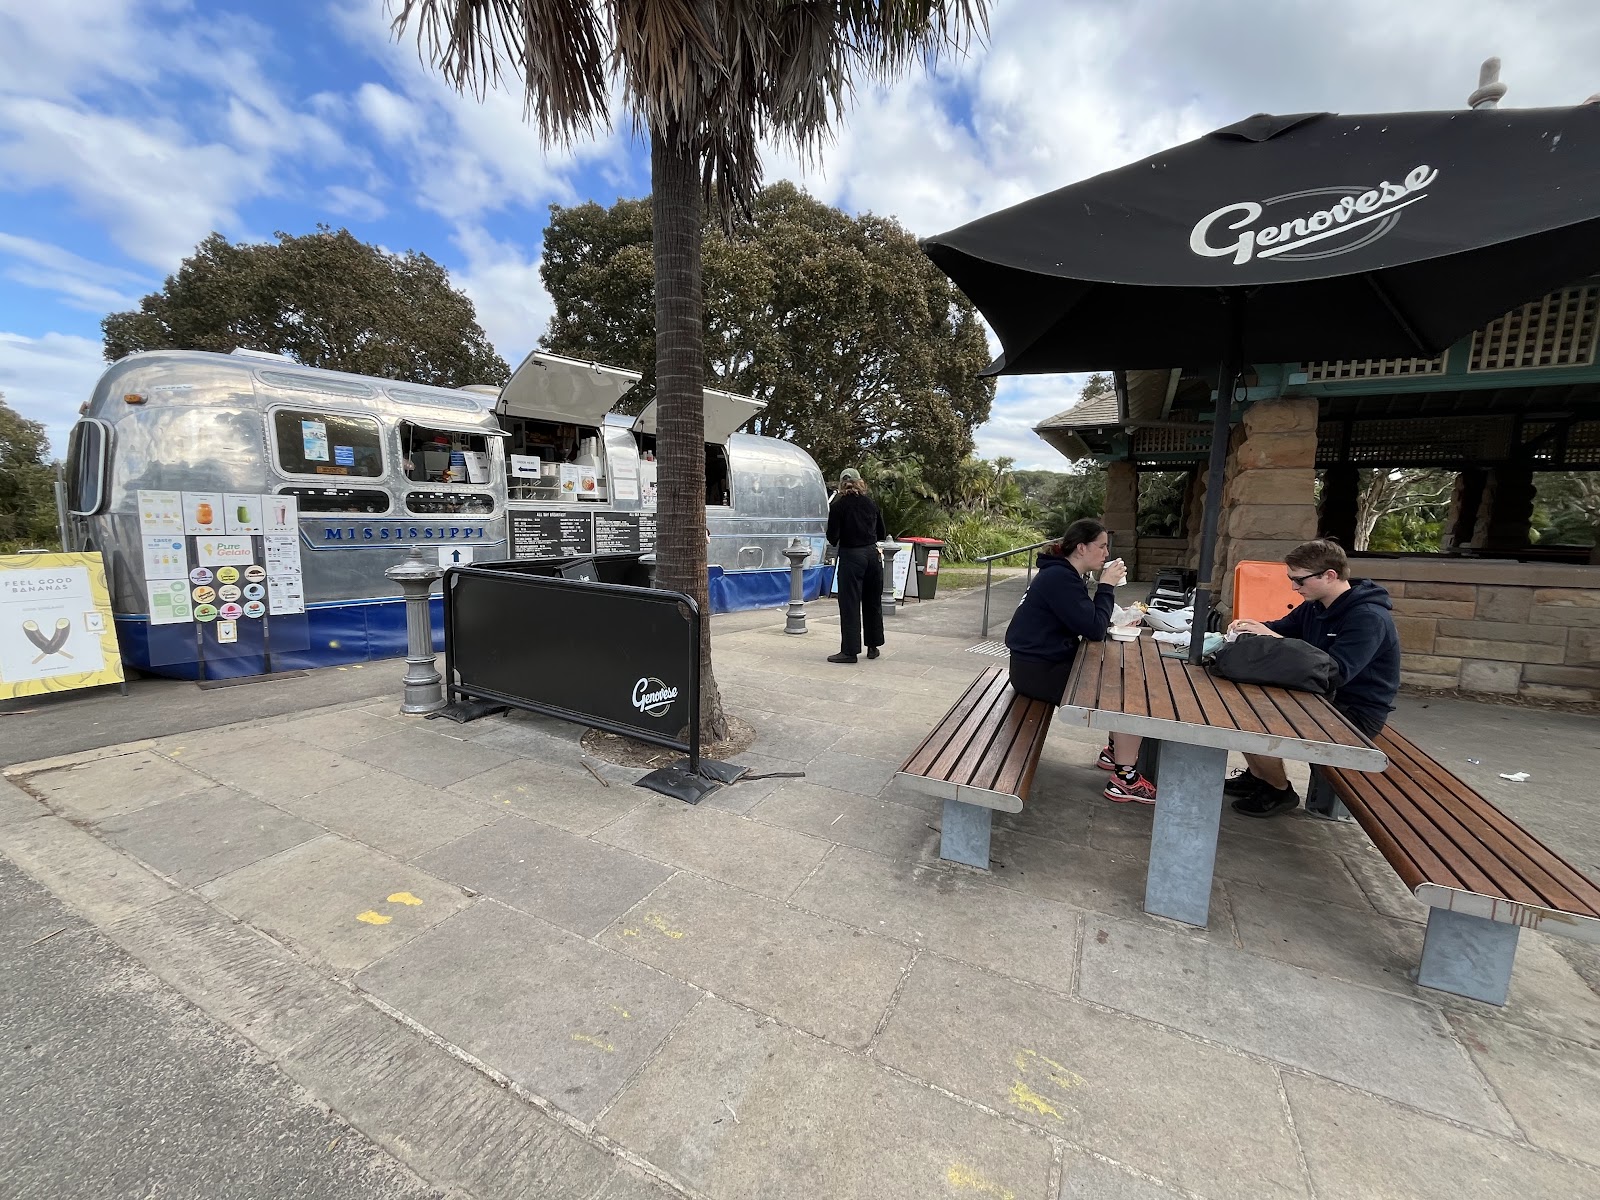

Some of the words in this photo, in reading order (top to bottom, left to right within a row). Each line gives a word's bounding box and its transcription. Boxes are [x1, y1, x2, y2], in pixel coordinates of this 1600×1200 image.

[1190, 165, 1438, 264] Genovese
[325, 527, 484, 540] MISSISSIPPI
[12, 584, 69, 593] BANANAS
[632, 677, 678, 712] Genovese
